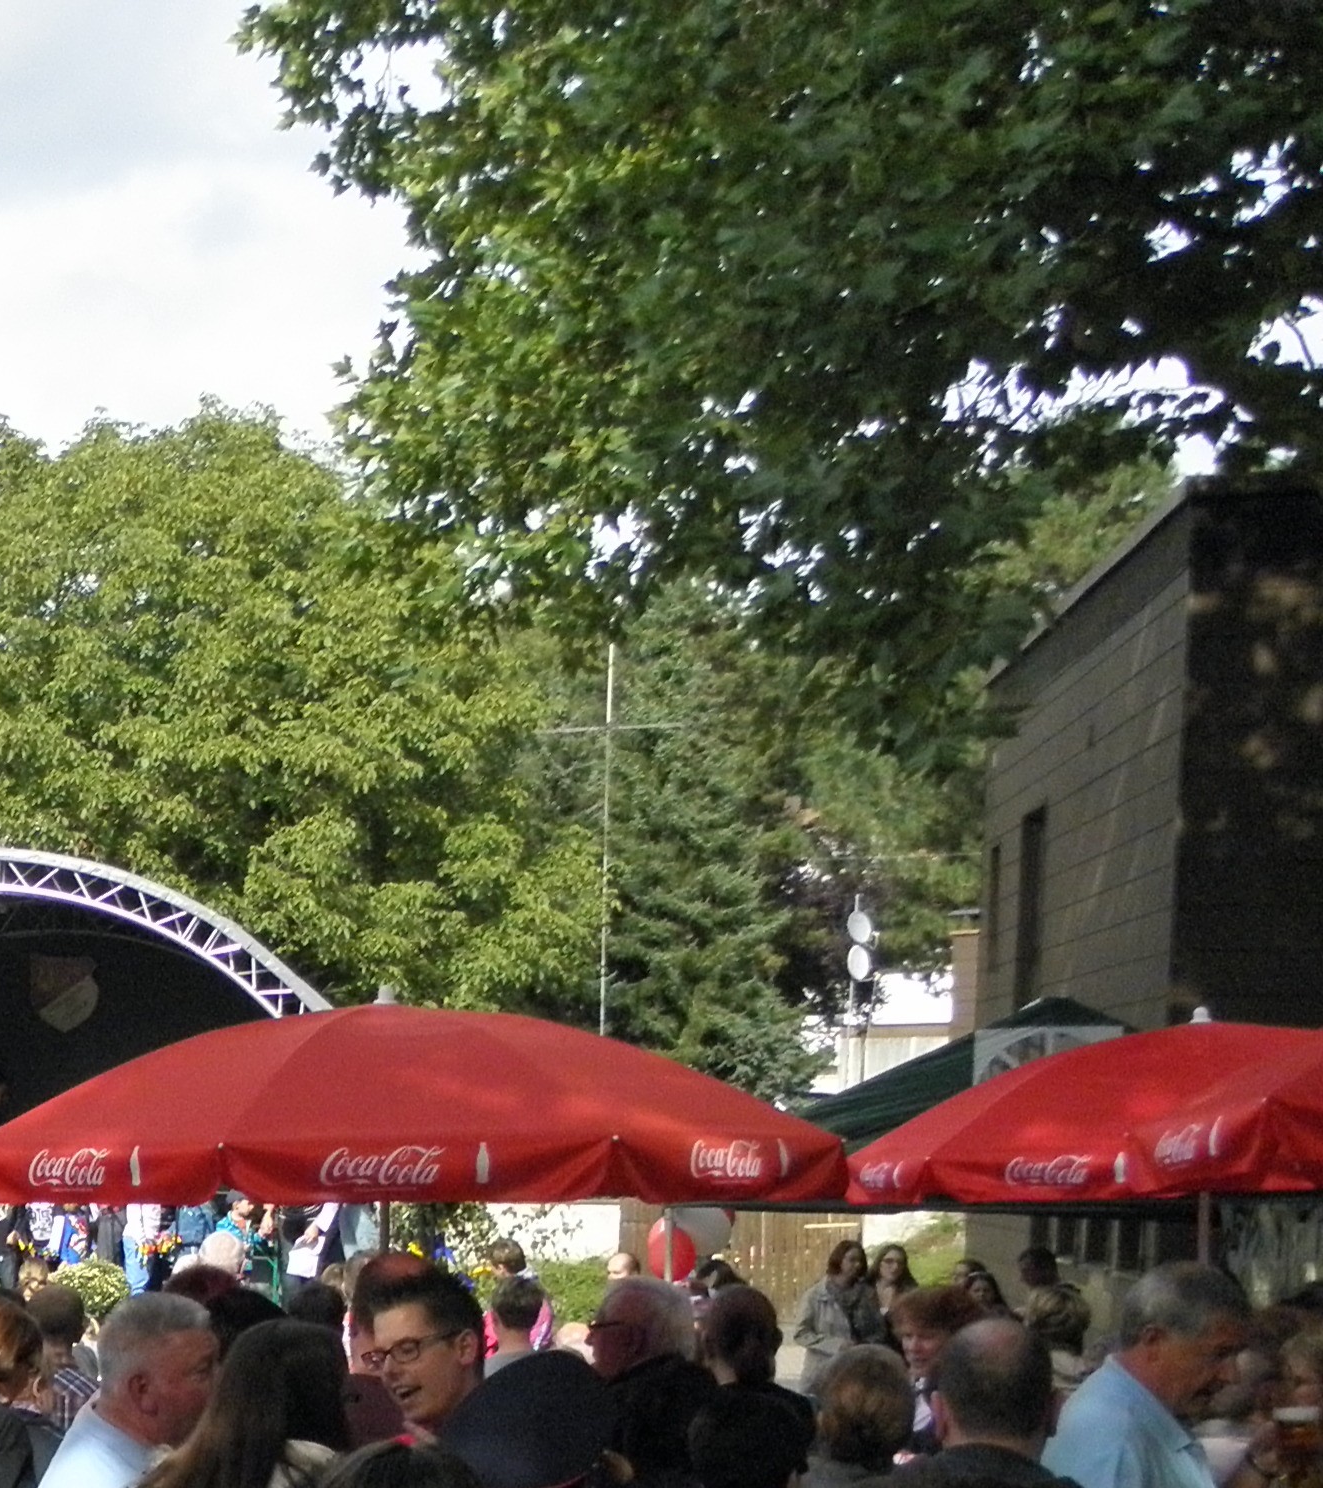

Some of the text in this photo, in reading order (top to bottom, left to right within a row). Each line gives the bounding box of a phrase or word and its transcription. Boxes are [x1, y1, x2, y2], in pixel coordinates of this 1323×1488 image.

[28, 1147, 112, 1187] Coca-Cola
[319, 1145, 448, 1187] Coca-Cola
[690, 1139, 762, 1178] Coca-Cola
[1004, 1154, 1093, 1186] Coca-Cola
